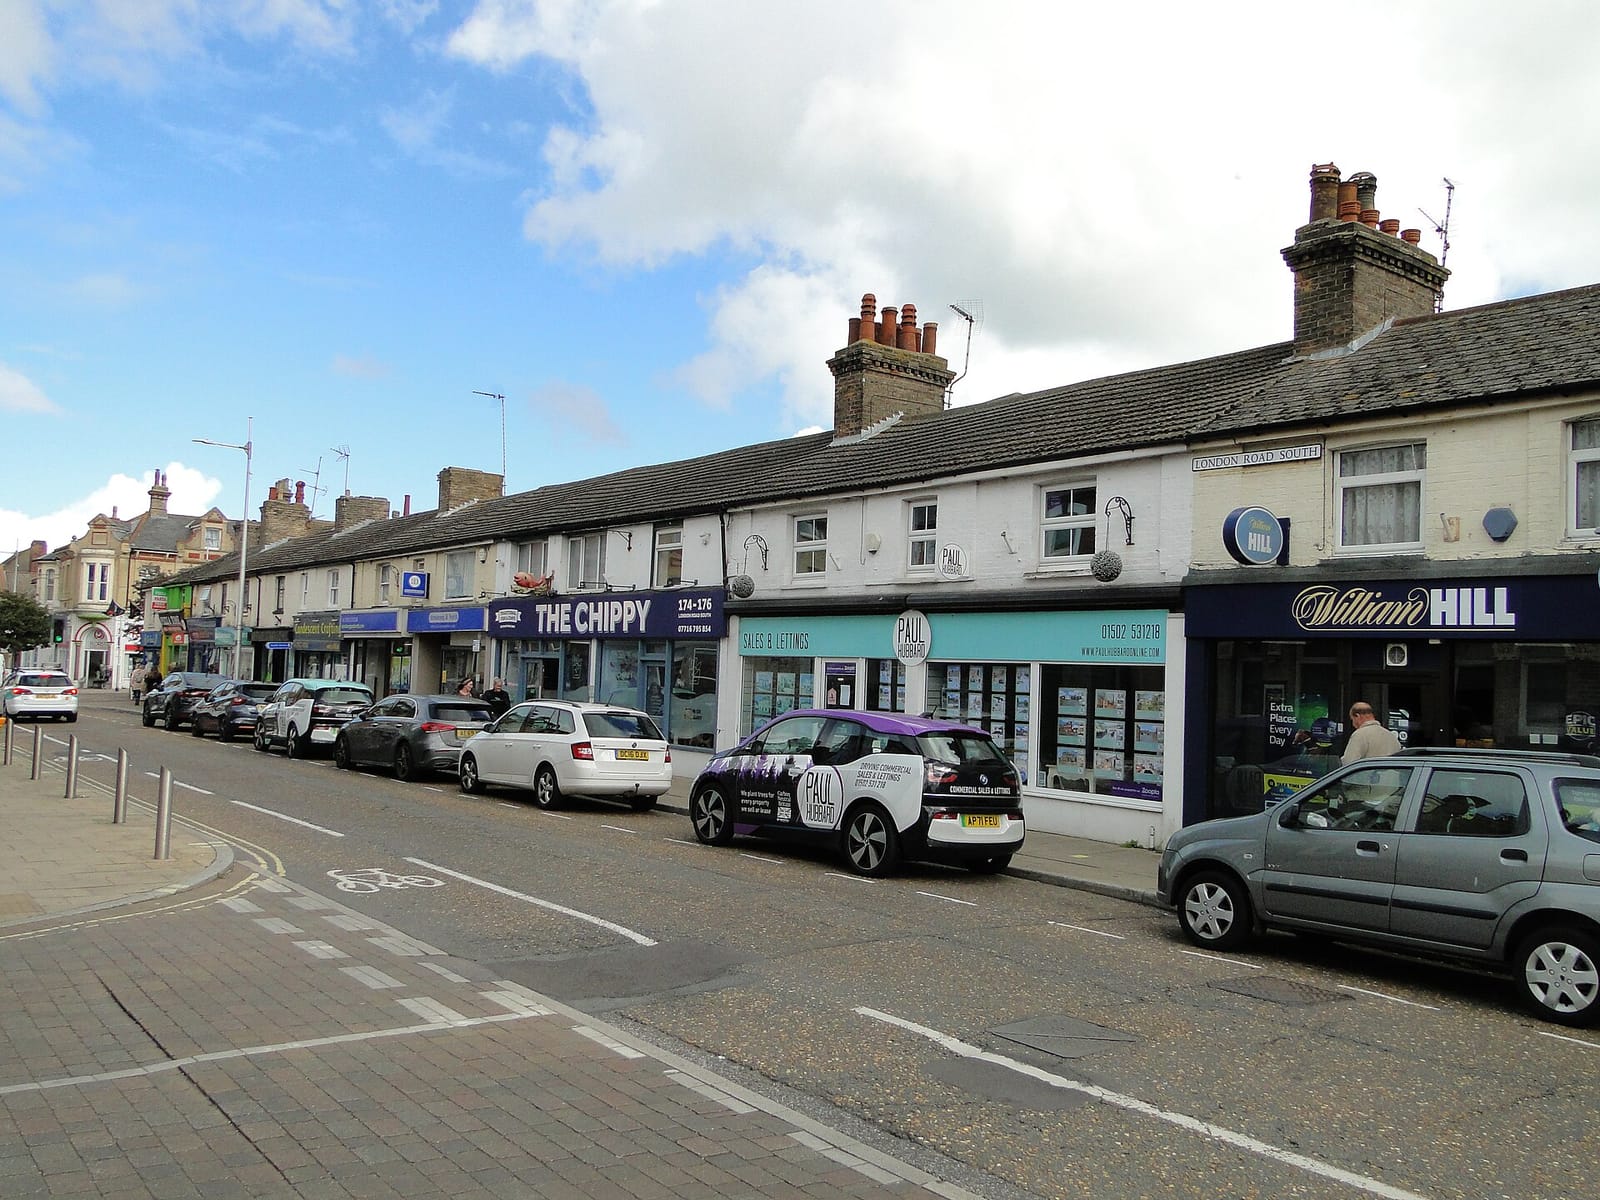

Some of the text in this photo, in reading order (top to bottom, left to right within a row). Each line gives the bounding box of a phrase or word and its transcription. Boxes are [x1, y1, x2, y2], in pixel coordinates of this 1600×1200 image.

[1195, 447, 1318, 469] LONDON ROAD SOUTH
[1248, 532, 1272, 553] HILL
[942, 548, 962, 566] PAUL
[942, 565, 962, 575] HUBBARD
[678, 598, 712, 610] 174-176
[1292, 585, 1516, 627] William HILL
[536, 600, 652, 633] THE CHIPPY
[898, 617, 925, 643] PAUL
[1102, 624, 1160, 639] 01502 531218
[744, 633, 809, 649] SALES & LETTINGS
[898, 643, 925, 658] HUBBARD
[1081, 648, 1160, 657] WWW.PAULHUBBARDONLINE.COM
[1270, 702, 1294, 712] Extra
[1270, 713, 1297, 724] Places
[1566, 714, 1596, 726] EPIC
[1269, 724, 1292, 736] Every
[1567, 726, 1596, 735] VALUE
[1269, 735, 1285, 747] Day
[860, 762, 912, 774] DRIVING COMMERCIAL
[857, 770, 872, 779] SALES
[877, 772, 901, 782] LETTINGS
[806, 772, 834, 805] PAUL
[806, 804, 834, 824] HUBBARD
[968, 815, 998, 826] AP71 FEU
